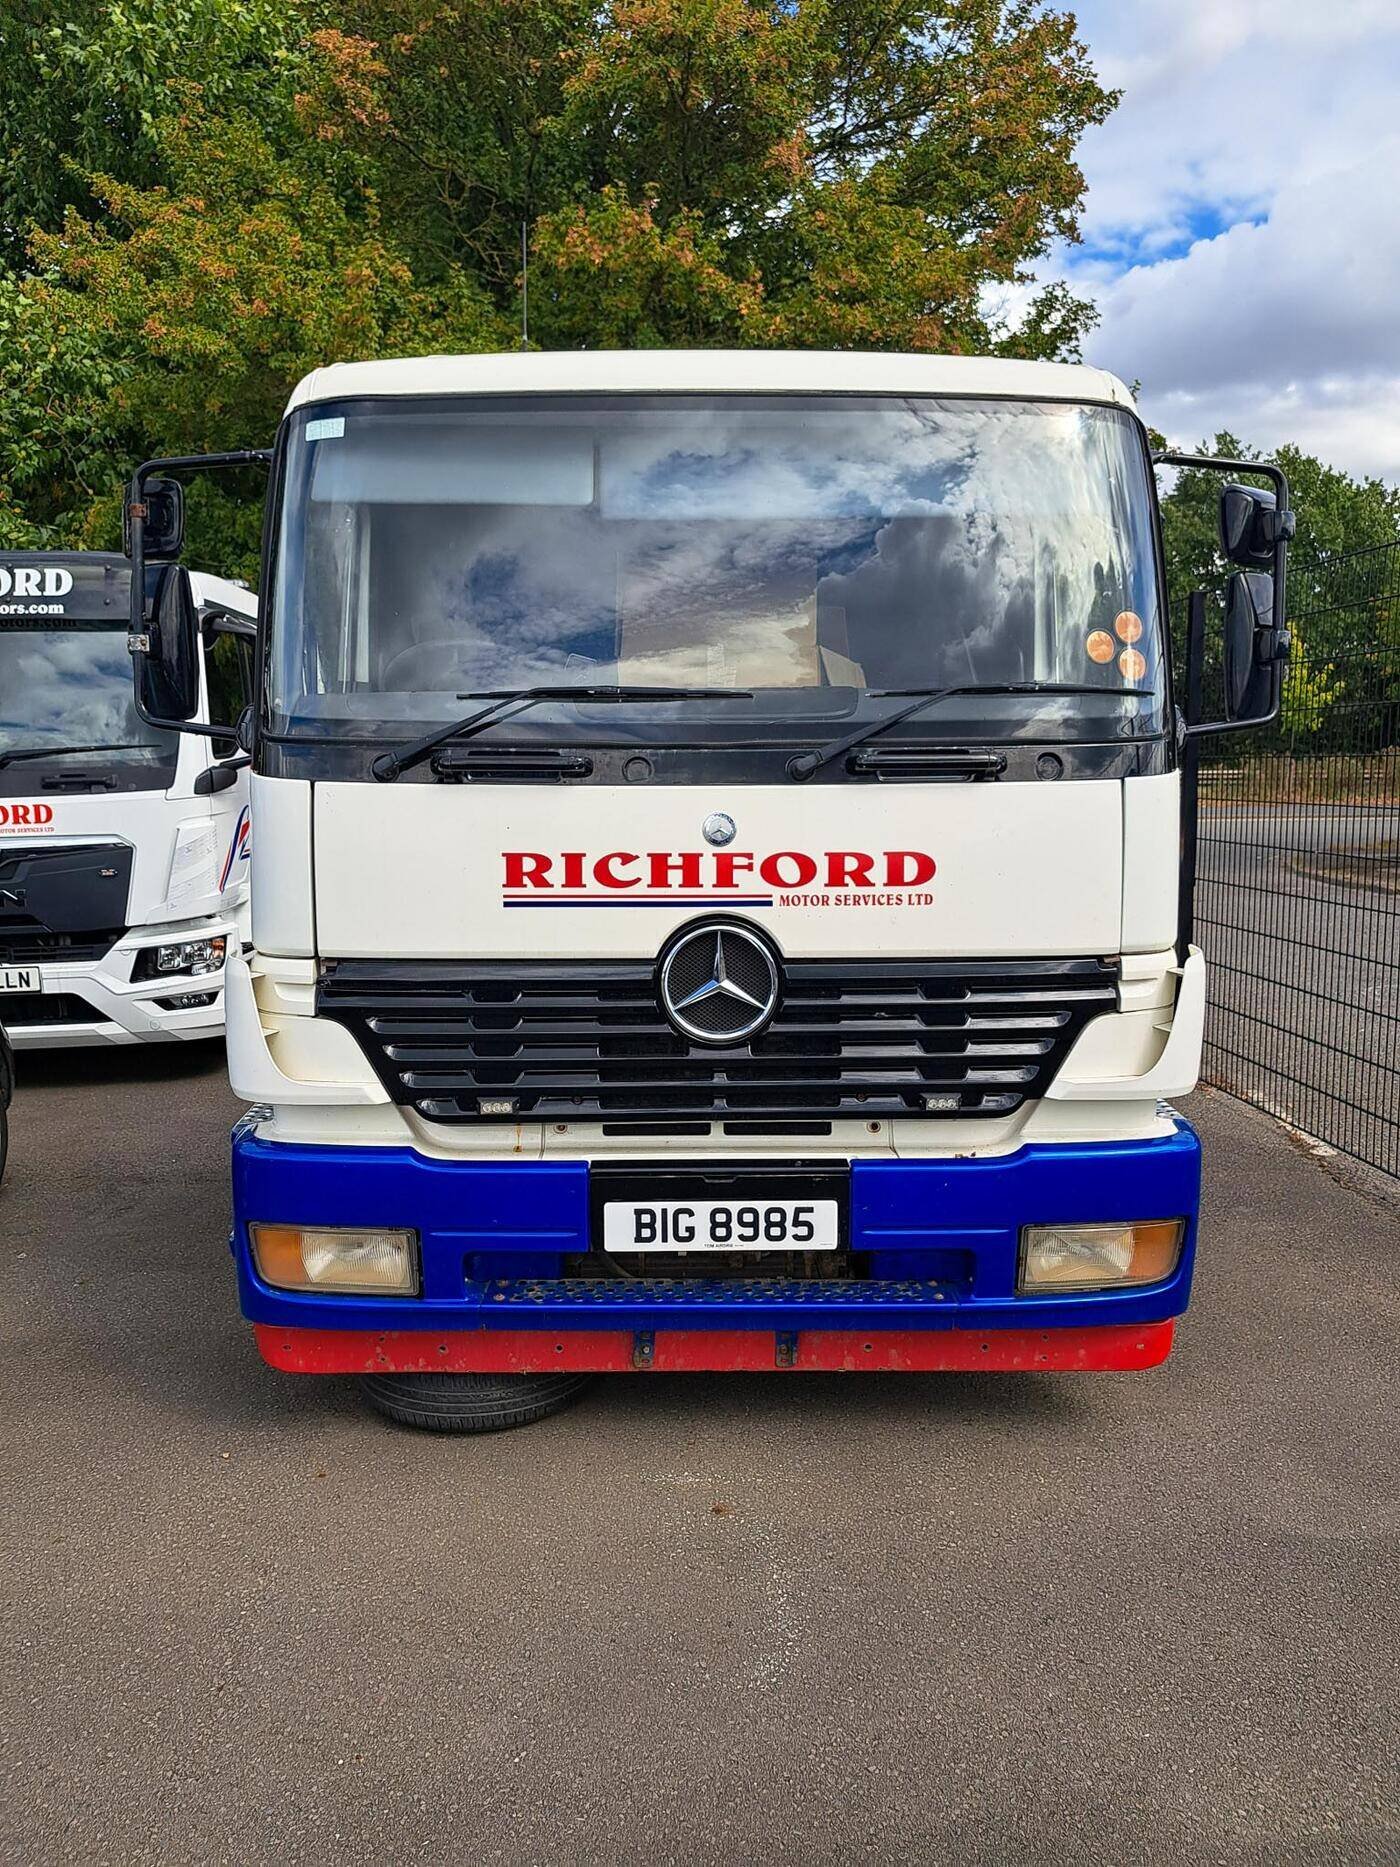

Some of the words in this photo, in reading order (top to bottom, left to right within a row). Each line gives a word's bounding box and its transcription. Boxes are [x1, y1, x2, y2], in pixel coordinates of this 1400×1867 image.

[501, 851, 937, 889] RICHFORD
[779, 894, 830, 907] MOTOR
[834, 894, 903, 906] SERVICES
[907, 893, 933, 905] LTD
[0, 971, 31, 989] LN
[633, 1208, 695, 1243] BIG
[709, 1206, 815, 1243] 8985
